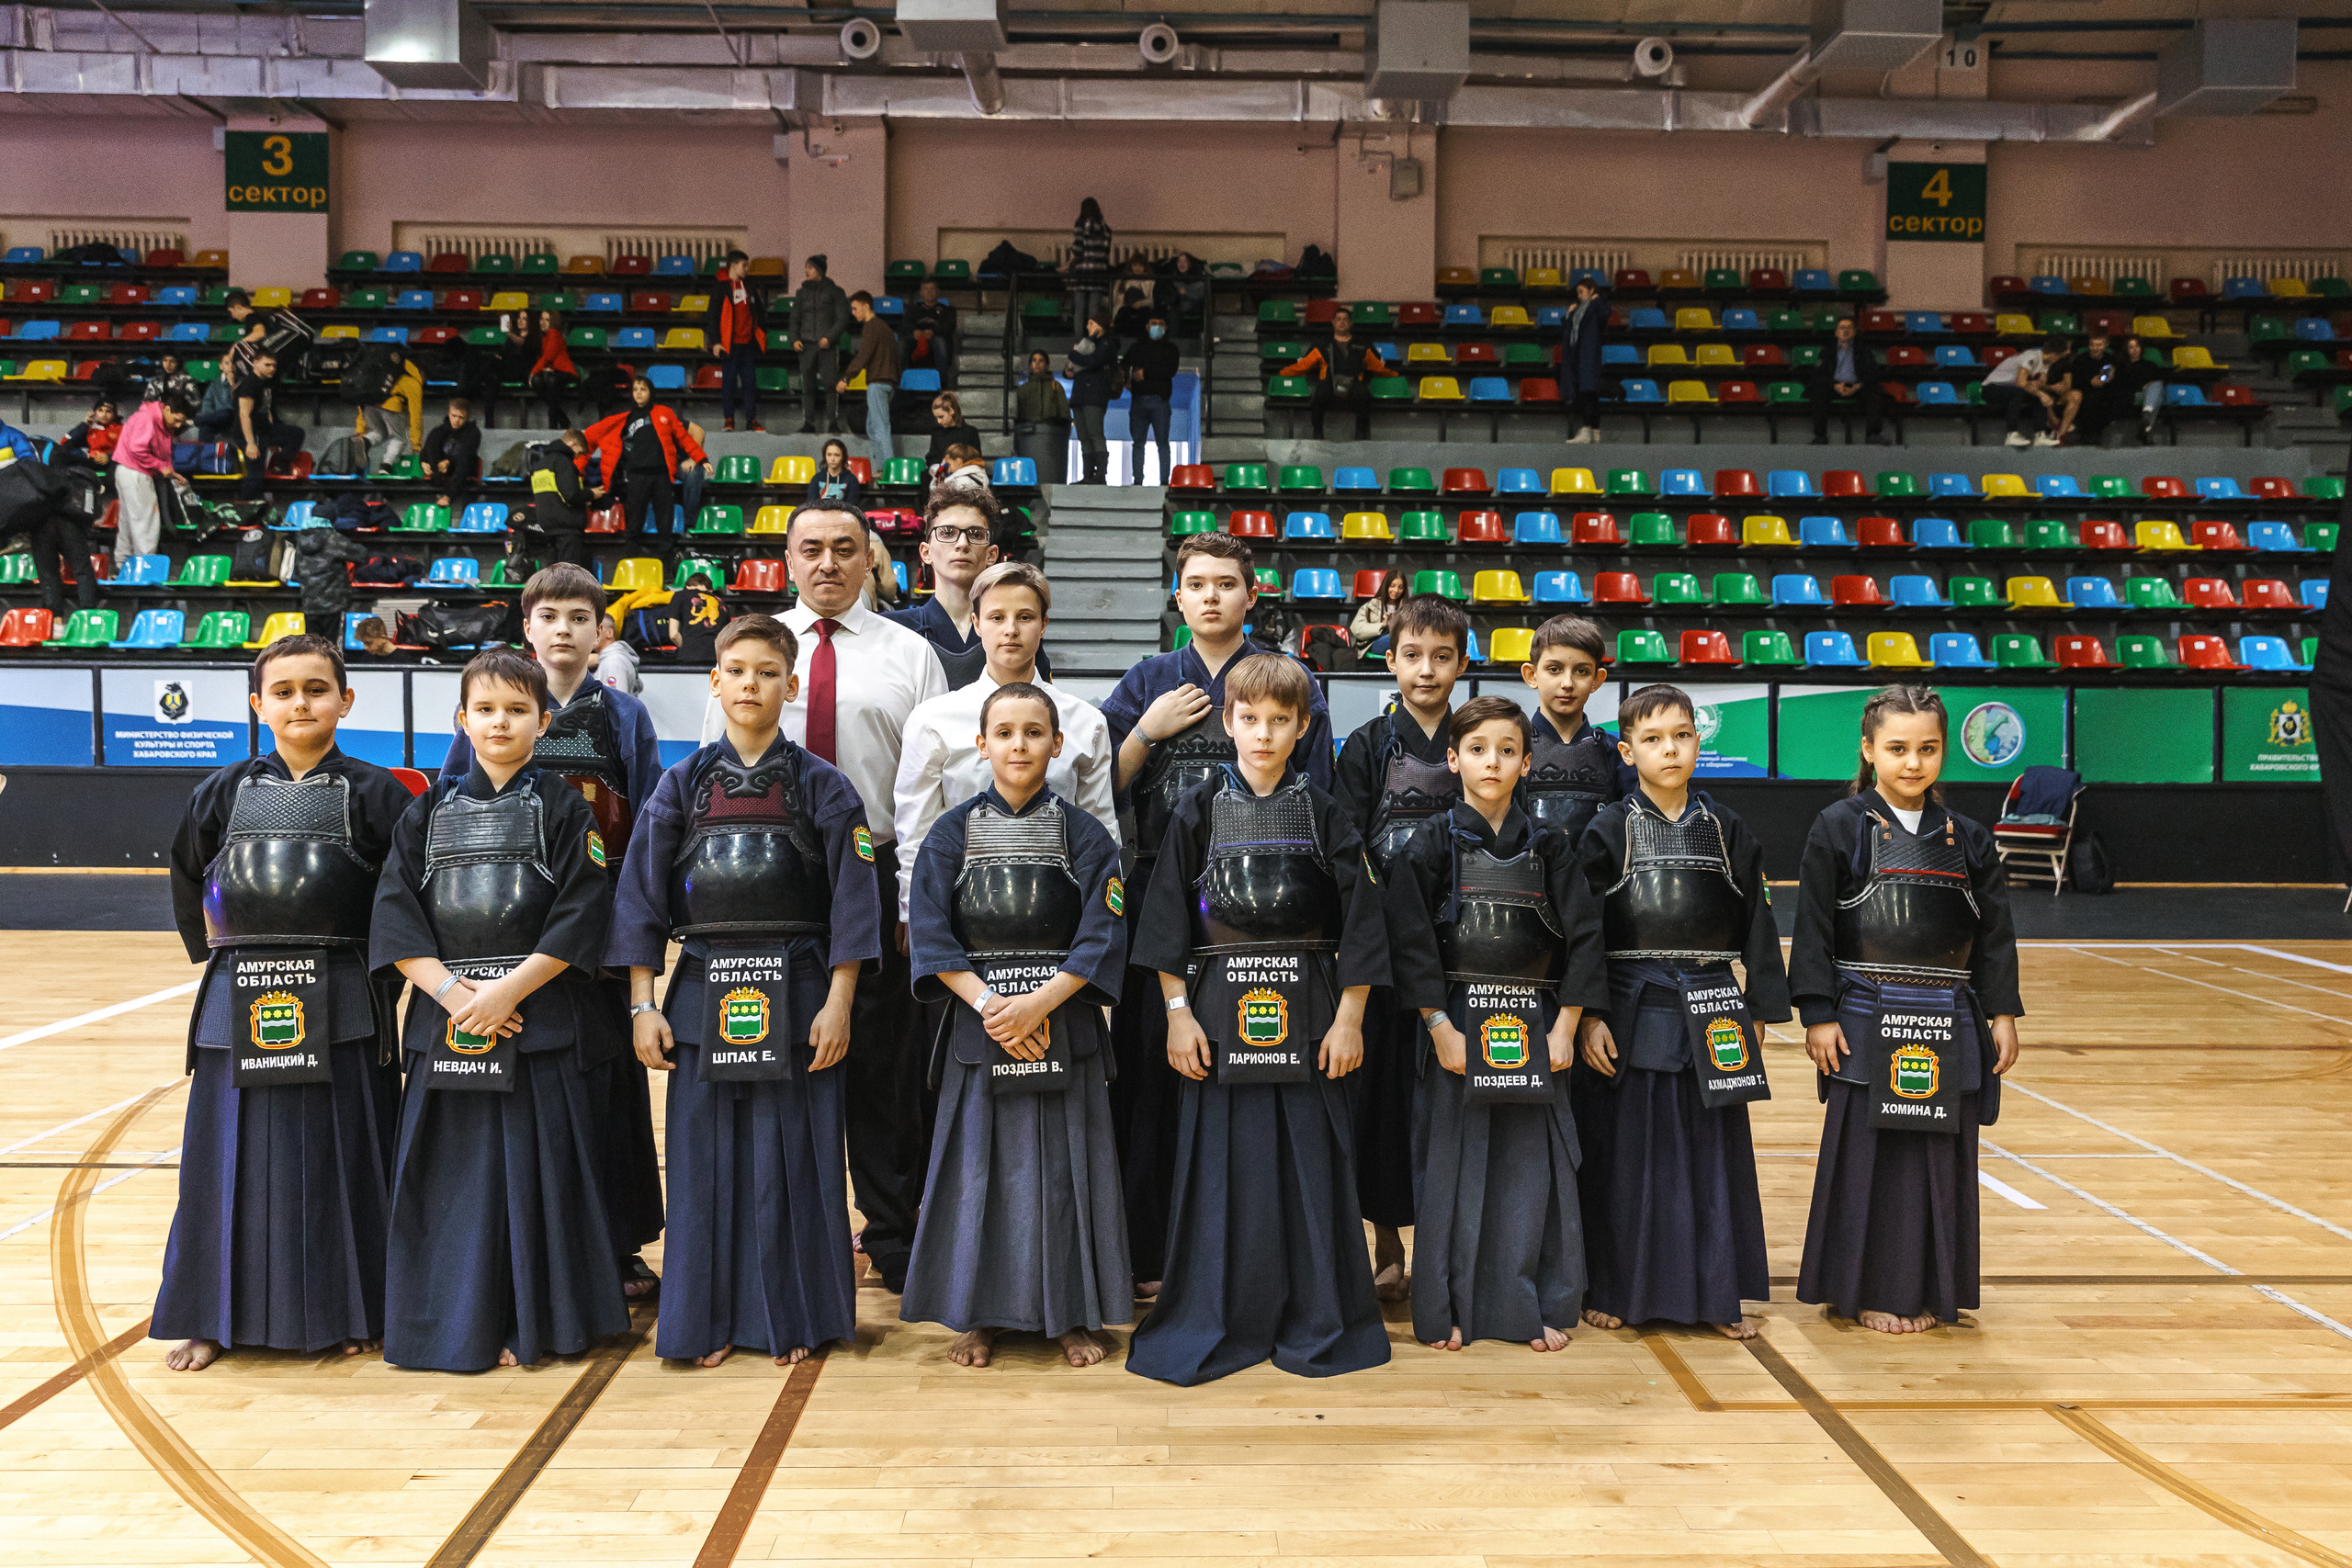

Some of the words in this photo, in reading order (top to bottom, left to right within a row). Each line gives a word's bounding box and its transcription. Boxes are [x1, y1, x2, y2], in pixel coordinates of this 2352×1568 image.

[1946, 49, 1976, 68] 10
[262, 135, 293, 176] 3
[1921, 169, 1953, 208] 4
[229, 186, 326, 209] сектор
[1889, 215, 1983, 238] сектор
[115, 730, 179, 739] МИНИСТЕРСТВО
[180, 729, 234, 739] ФИЗИЧЕСКОЙ
[134, 740, 176, 749] КУЛЬТУРЫ
[184, 740, 215, 749] СПОРТА
[132, 750, 196, 759] ХАБАРОВСКОГО
[197, 750, 217, 759] КРАЯ
[236, 959, 315, 974] АМУРСКАЯ
[709, 957, 783, 970] АМУРСКАЯ
[1227, 956, 1298, 969] АМУРСКАЯ
[236, 973, 317, 987] ОБЛАСТЬ
[709, 970, 783, 983] ОБЛАСТЬ
[986, 965, 1057, 982] АМУРСКАЯ
[1227, 971, 1299, 983] ОБЛАСТЬ
[988, 980, 1050, 995] ОБЛАСТ
[1467, 984, 1535, 996] АМУРСКАЯ
[1687, 986, 1740, 1002] АМУРСКАЯ
[1468, 997, 1538, 1009] ОБЛАСТЬ
[1690, 998, 1745, 1015] ОБЛАСТЬ
[1881, 1013, 1952, 1028] АМУРСКАЯ
[1881, 1027, 1952, 1041] ОБЛАСТЬ
[241, 1052, 305, 1070] ИВАНИЦКИЙ
[307, 1054, 319, 1067] Д.
[712, 1050, 758, 1064] ШПАК
[762, 1050, 776, 1061] Е.
[1228, 1053, 1287, 1065] ЛАРИОНОВ
[1290, 1053, 1301, 1065] Е.
[433, 1060, 486, 1075] НЕВДАЧ
[490, 1062, 503, 1074] И.
[992, 1061, 1048, 1077] ПОЗДЕЕВ
[1051, 1061, 1064, 1073] В.
[1474, 1075, 1528, 1089] ПОЗДЕЕВ
[1531, 1075, 1544, 1088] Д.
[1708, 1076, 1756, 1091] АХМАДЖОНОВ
[1756, 1074, 1766, 1085] Т.
[1881, 1102, 1932, 1117] ХОМИНА
[1933, 1106, 1948, 1120] Д.
